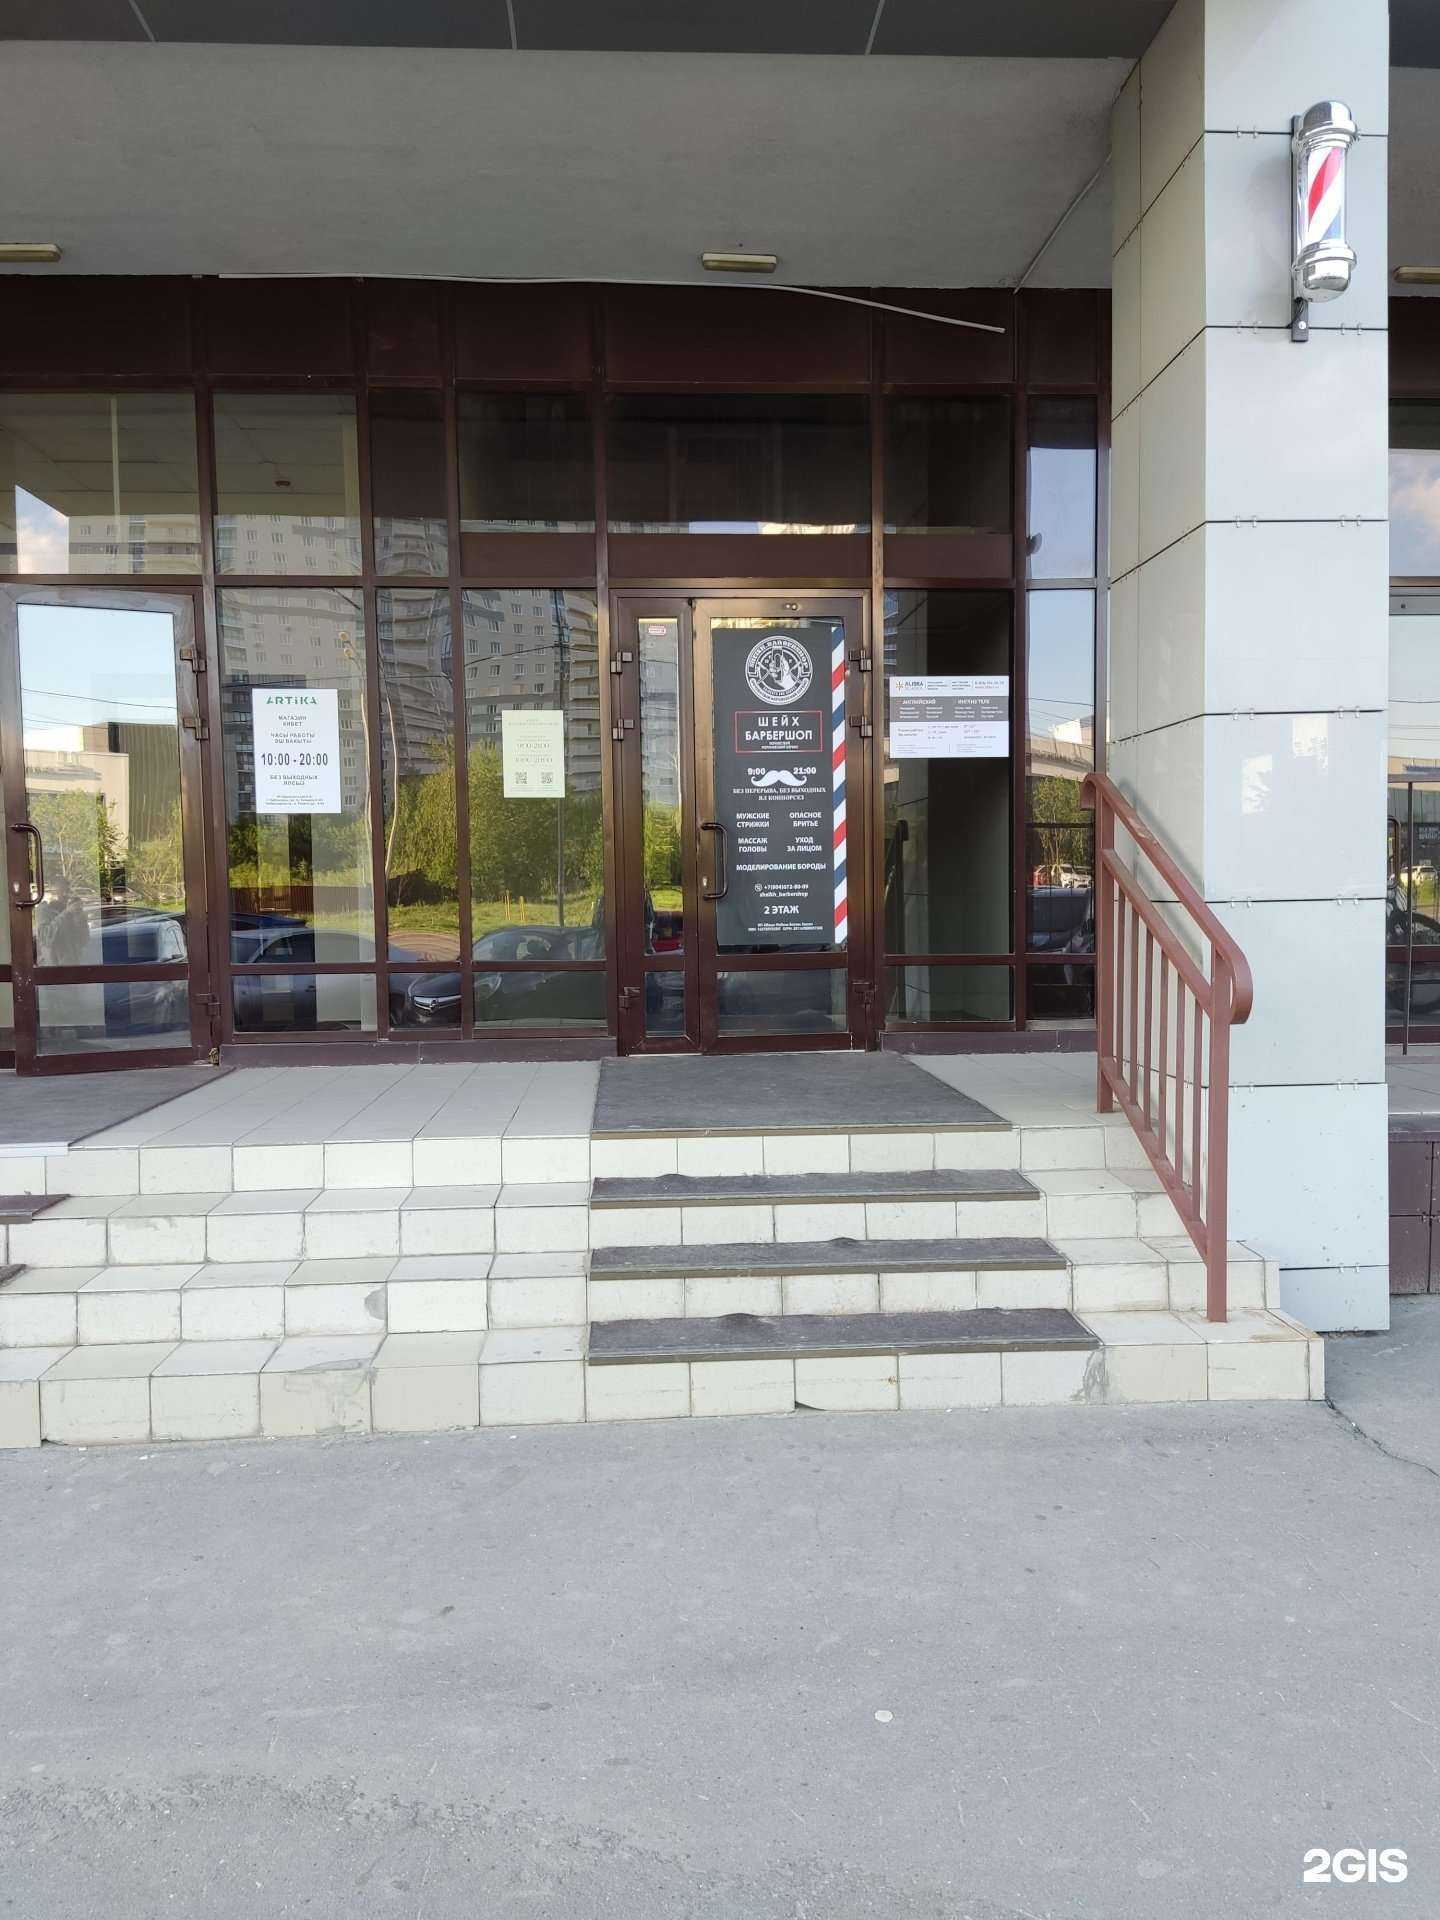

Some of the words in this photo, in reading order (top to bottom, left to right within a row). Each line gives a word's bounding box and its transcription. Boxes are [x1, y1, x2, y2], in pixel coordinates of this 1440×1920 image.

[758, 714, 800, 727] ШЕЙХ
[745, 729, 813, 741] БАРБЕРШОП
[261, 753, 290, 766] 10:00
[299, 753, 328, 766] 20:00
[747, 767, 766, 776] 9:00
[793, 766, 817, 775] 21:00
[736, 812, 770, 820] МУЖСКИЕ
[789, 811, 822, 819] ОПАСНОЕ
[795, 836, 814, 844] УХОД
[796, 844, 822, 853] ЛИЦОМ
[736, 863, 797, 872] МОДЕЛИРОВАНИЕ
[797, 862, 826, 871] БОРОДЫ
[763, 905, 770, 914] 2
[771, 904, 800, 914] ЭТАЖ
